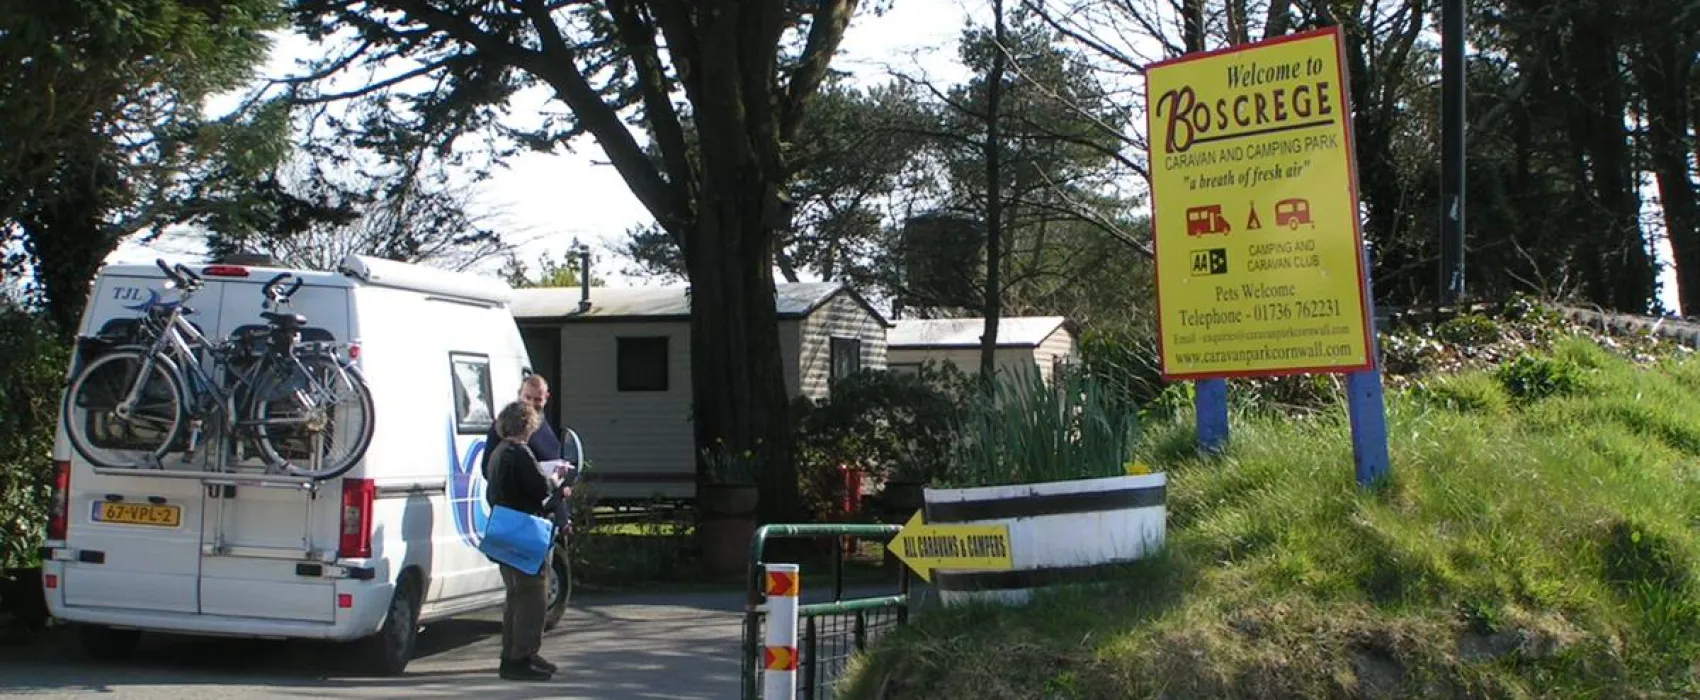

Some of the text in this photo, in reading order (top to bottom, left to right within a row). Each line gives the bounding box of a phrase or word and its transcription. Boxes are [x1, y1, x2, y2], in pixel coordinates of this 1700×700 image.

[1227, 57, 1323, 89] Welcome to
[1156, 81, 1332, 154] BOSCREGE
[1165, 133, 1339, 171] CARAVAN AND CAMPING PARK
[1199, 170, 1235, 188] breath
[1238, 167, 1252, 188] of
[1251, 164, 1282, 187] fresh
[1248, 239, 1316, 257] CAMPING AND
[1193, 253, 1208, 272] AA
[1247, 254, 1321, 273] CARAVAN CLUB
[113, 286, 143, 300] TJL
[1215, 281, 1296, 302] Pets Welcome
[1179, 306, 1242, 330] Telephone
[1253, 303, 1292, 321] 01736
[1296, 299, 1342, 319] 762231
[1173, 332, 1197, 345] Email
[1175, 340, 1352, 366] www.caravanparkcornwall.com
[106, 505, 171, 523] 67-VPL-2
[903, 536, 917, 557] ALL
[917, 535, 959, 557] CARAVANS
[967, 534, 1007, 557] CAMPERS
